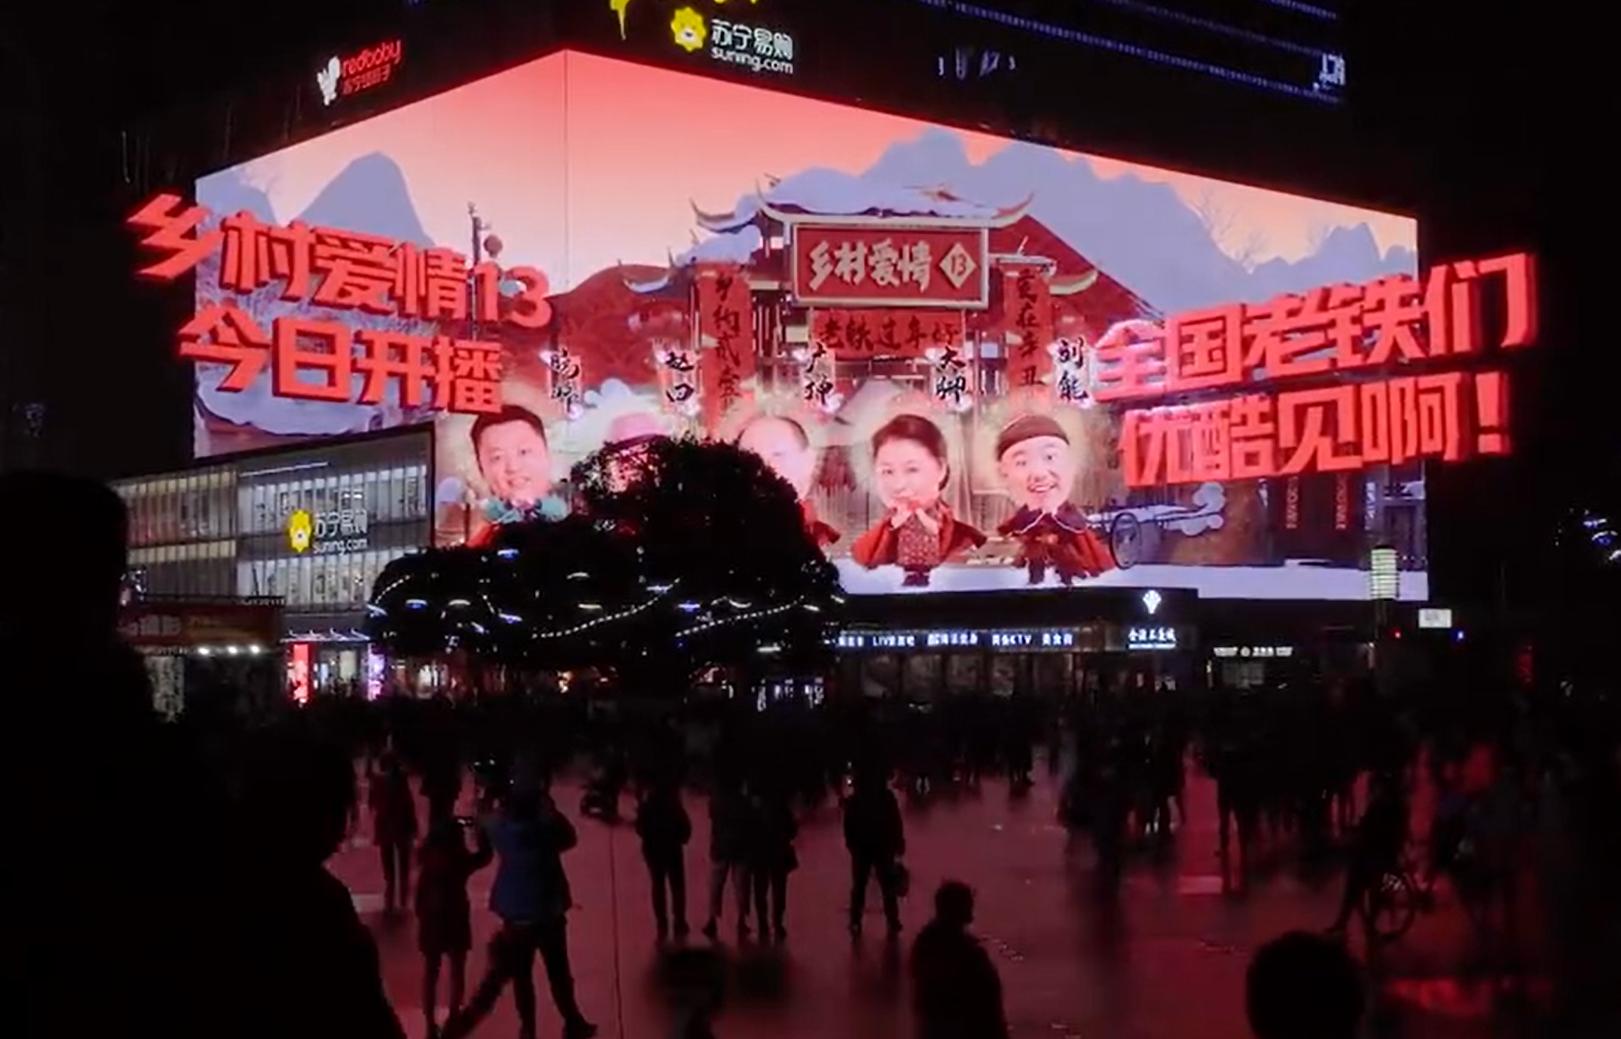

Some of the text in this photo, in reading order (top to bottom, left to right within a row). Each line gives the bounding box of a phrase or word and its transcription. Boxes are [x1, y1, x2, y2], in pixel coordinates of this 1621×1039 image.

[711, 18, 793, 60] 苏宁易购
[711, 46, 793, 74] suning.com
[126, 193, 553, 329] 乡村爱情13
[808, 237, 931, 293] 乡村爱情
[178, 301, 504, 417] 今日开播
[1094, 252, 1535, 401] 全国老铁们
[1058, 336, 1089, 401] 刘能
